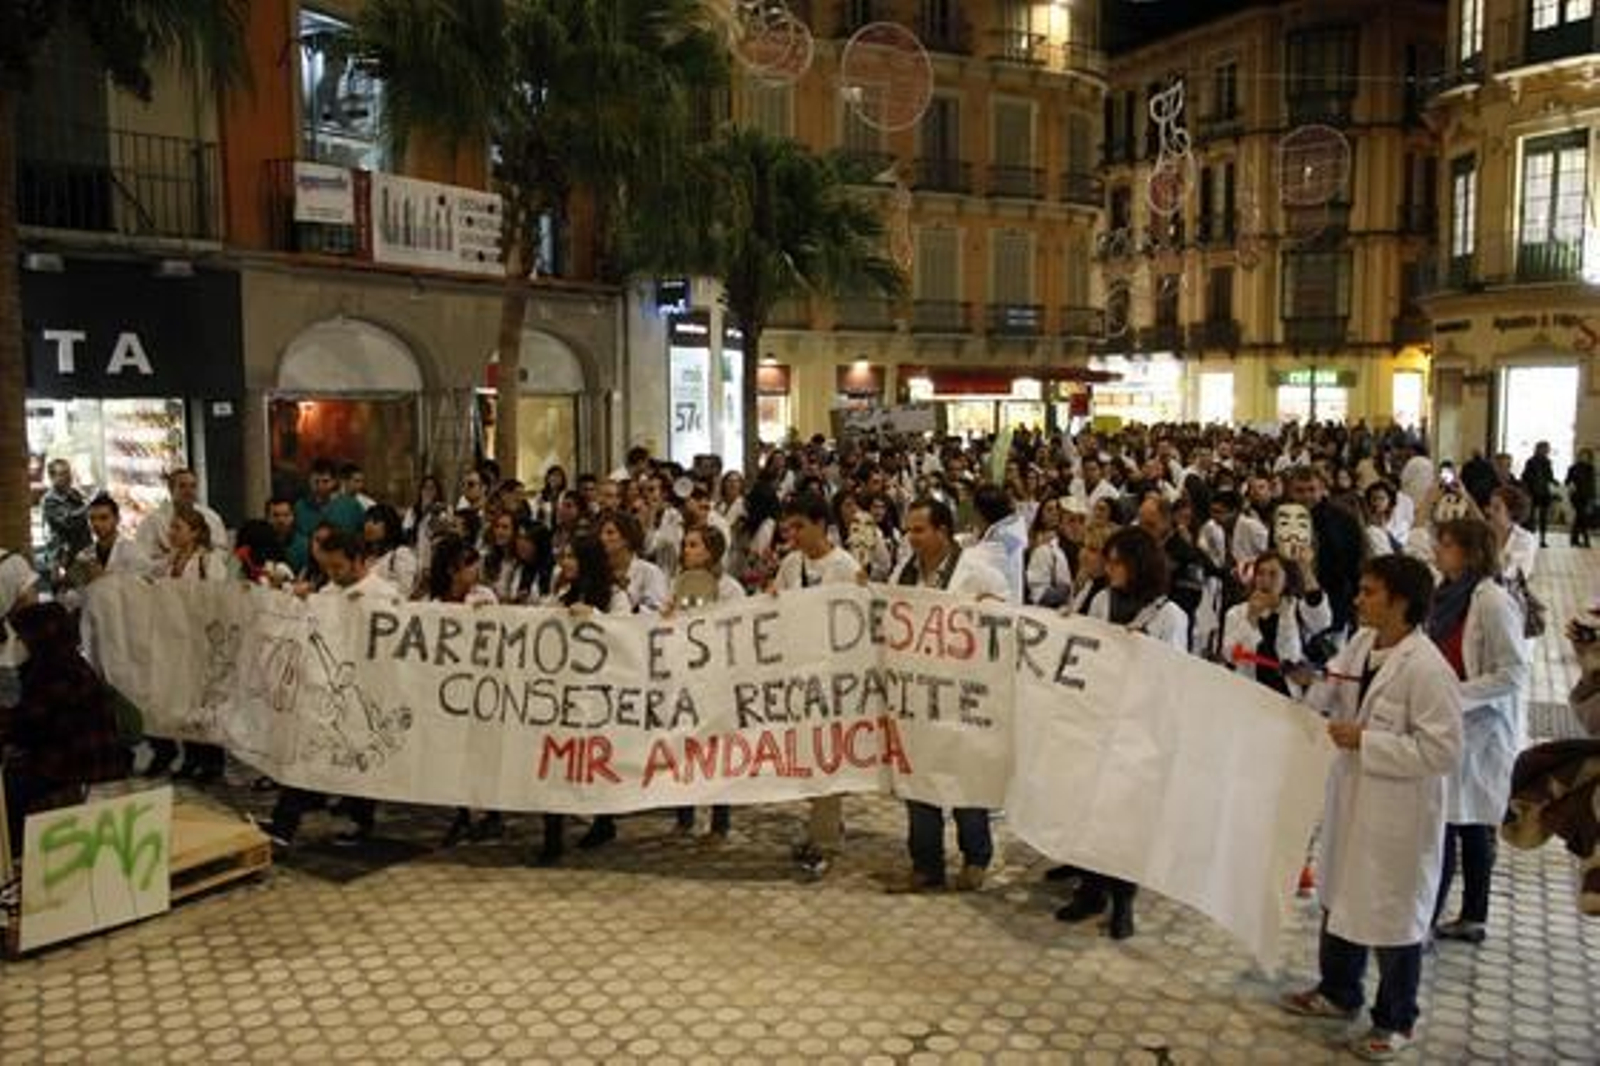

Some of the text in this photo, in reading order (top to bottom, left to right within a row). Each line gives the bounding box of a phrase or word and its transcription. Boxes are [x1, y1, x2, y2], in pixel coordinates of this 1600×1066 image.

[366, 612, 609, 675] PAREMOS
[648, 612, 783, 681] ESTE
[438, 673, 699, 731] CONSEJERA
[537, 735, 622, 784] MIR
